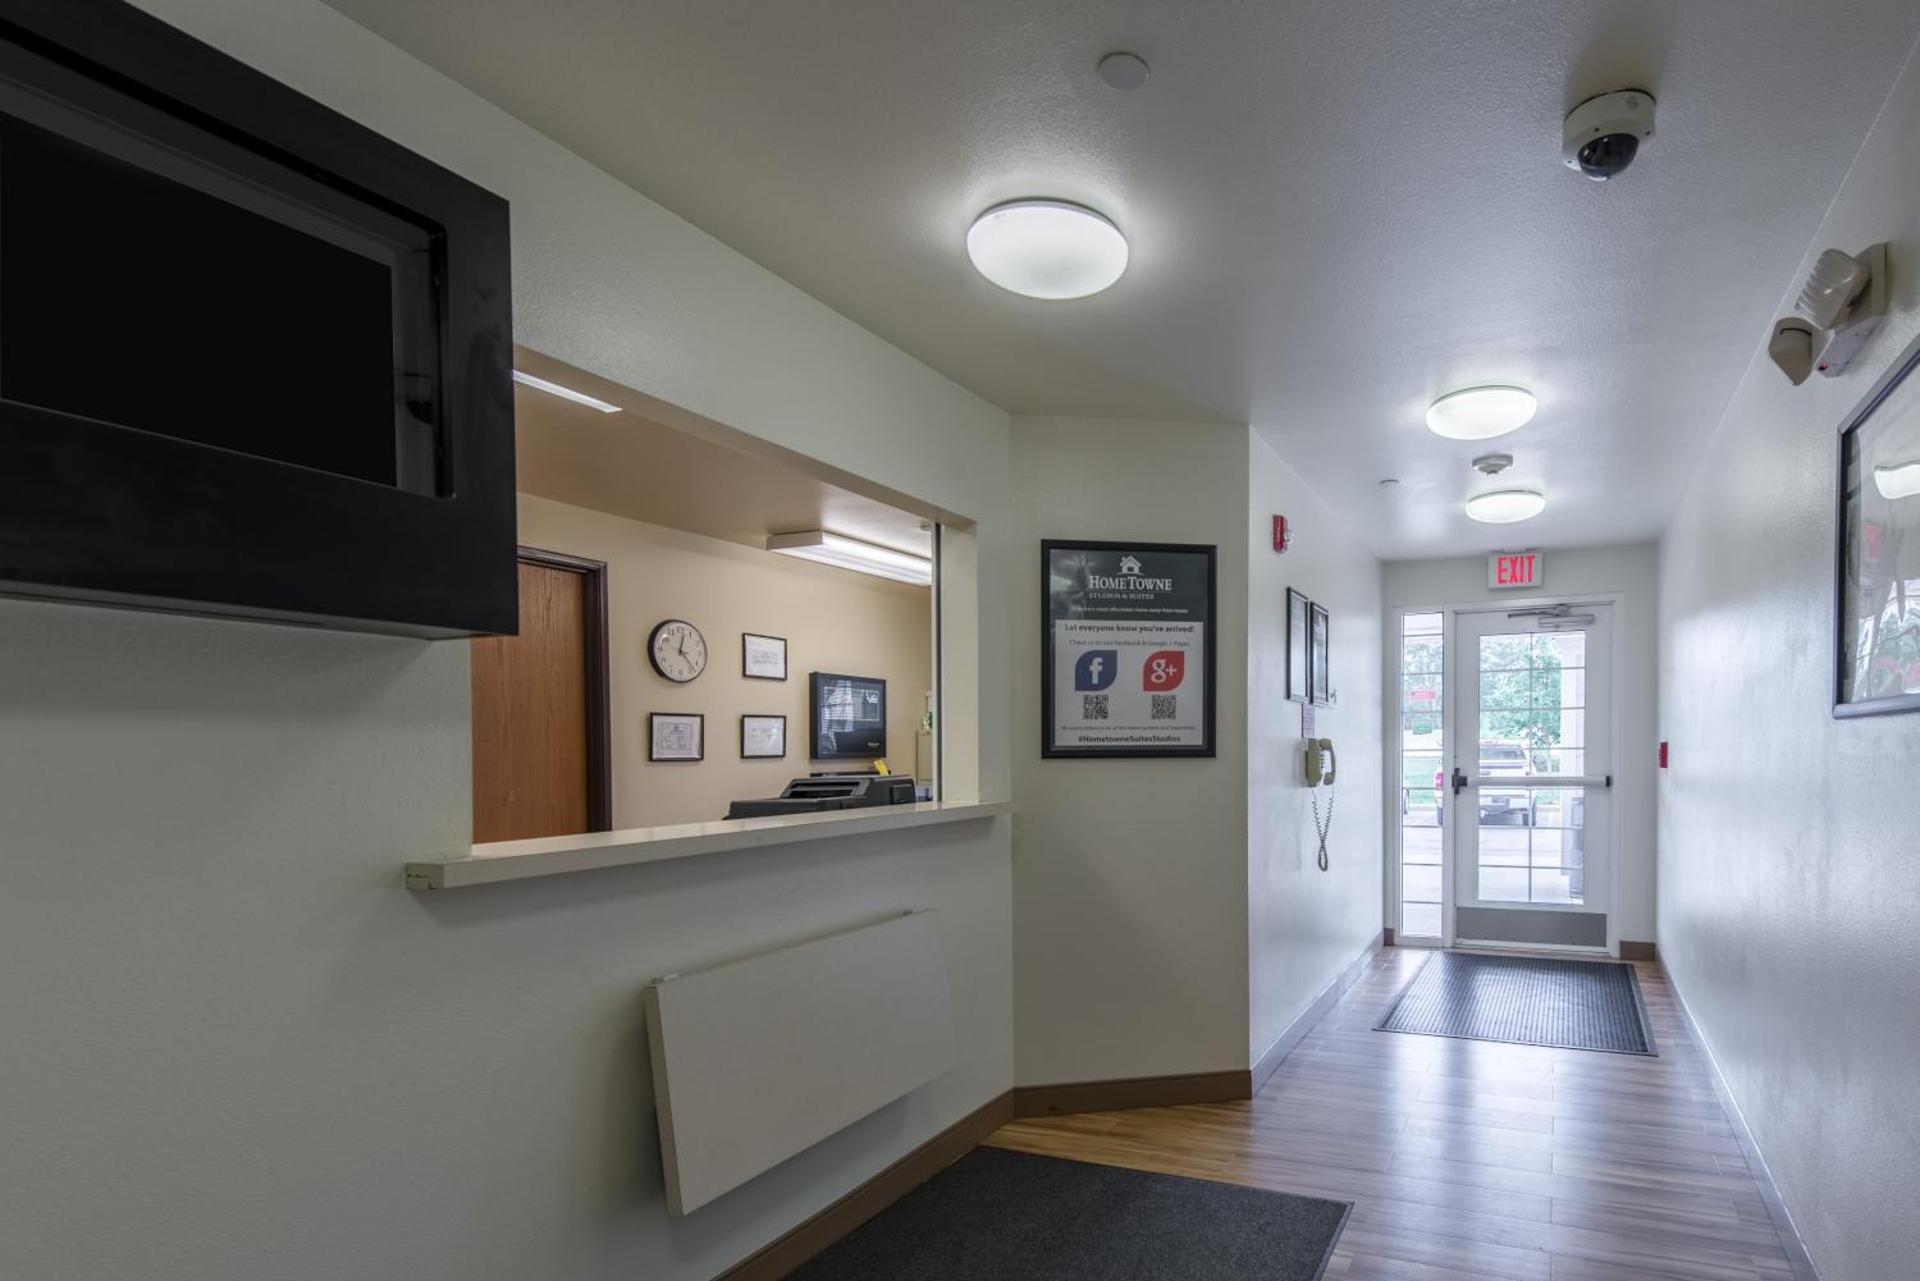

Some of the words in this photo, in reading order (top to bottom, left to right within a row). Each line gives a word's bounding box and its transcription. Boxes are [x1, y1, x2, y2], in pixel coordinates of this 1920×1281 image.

[1496, 554, 1535, 584] EXIT
[1088, 575, 1172, 591] HOMETOWNE
[1078, 624, 1115, 633] everyone
[1139, 624, 1164, 633] you've
